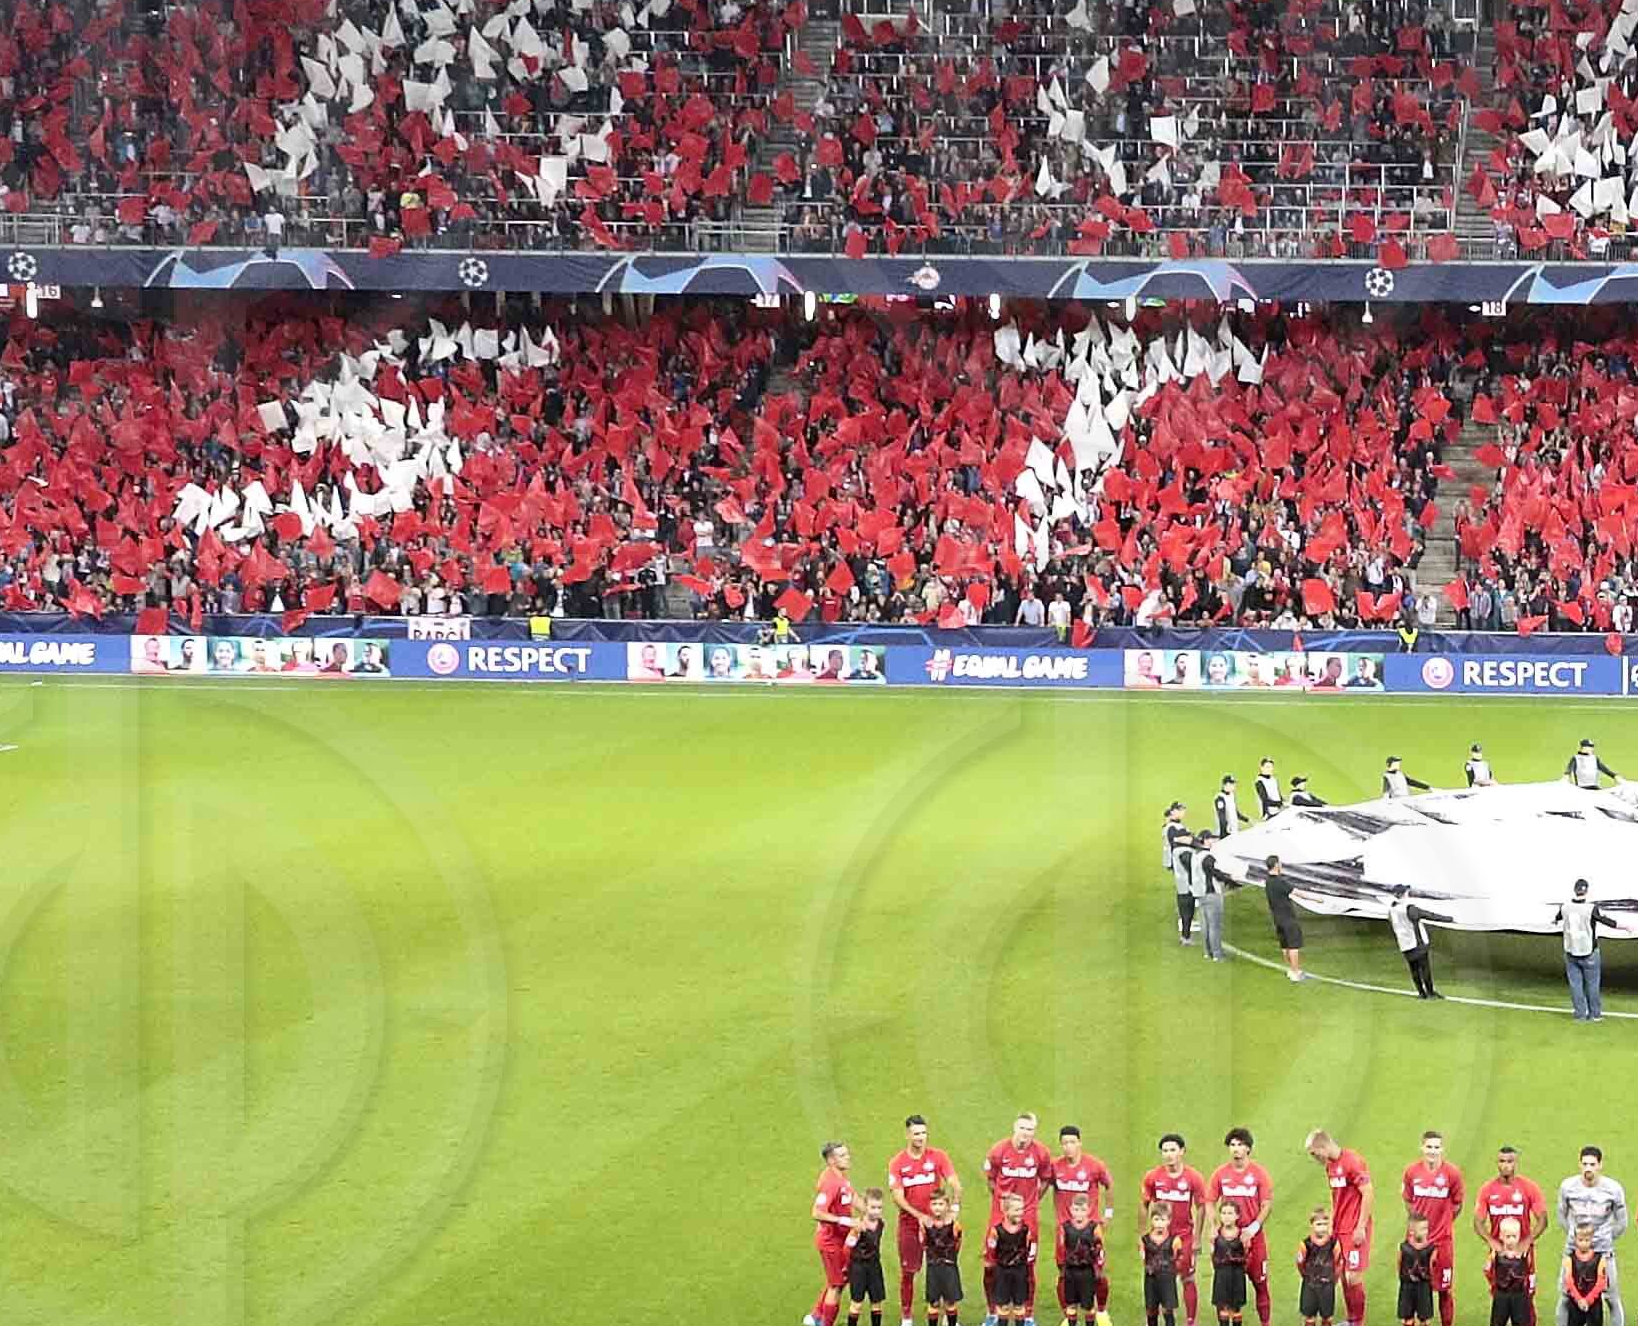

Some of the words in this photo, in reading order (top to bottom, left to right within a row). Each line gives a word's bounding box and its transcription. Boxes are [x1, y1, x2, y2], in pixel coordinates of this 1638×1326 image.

[1487, 303, 1503, 315] 18
[468, 646, 592, 674] RESPECT
[1463, 662, 1588, 689] RESPECT
